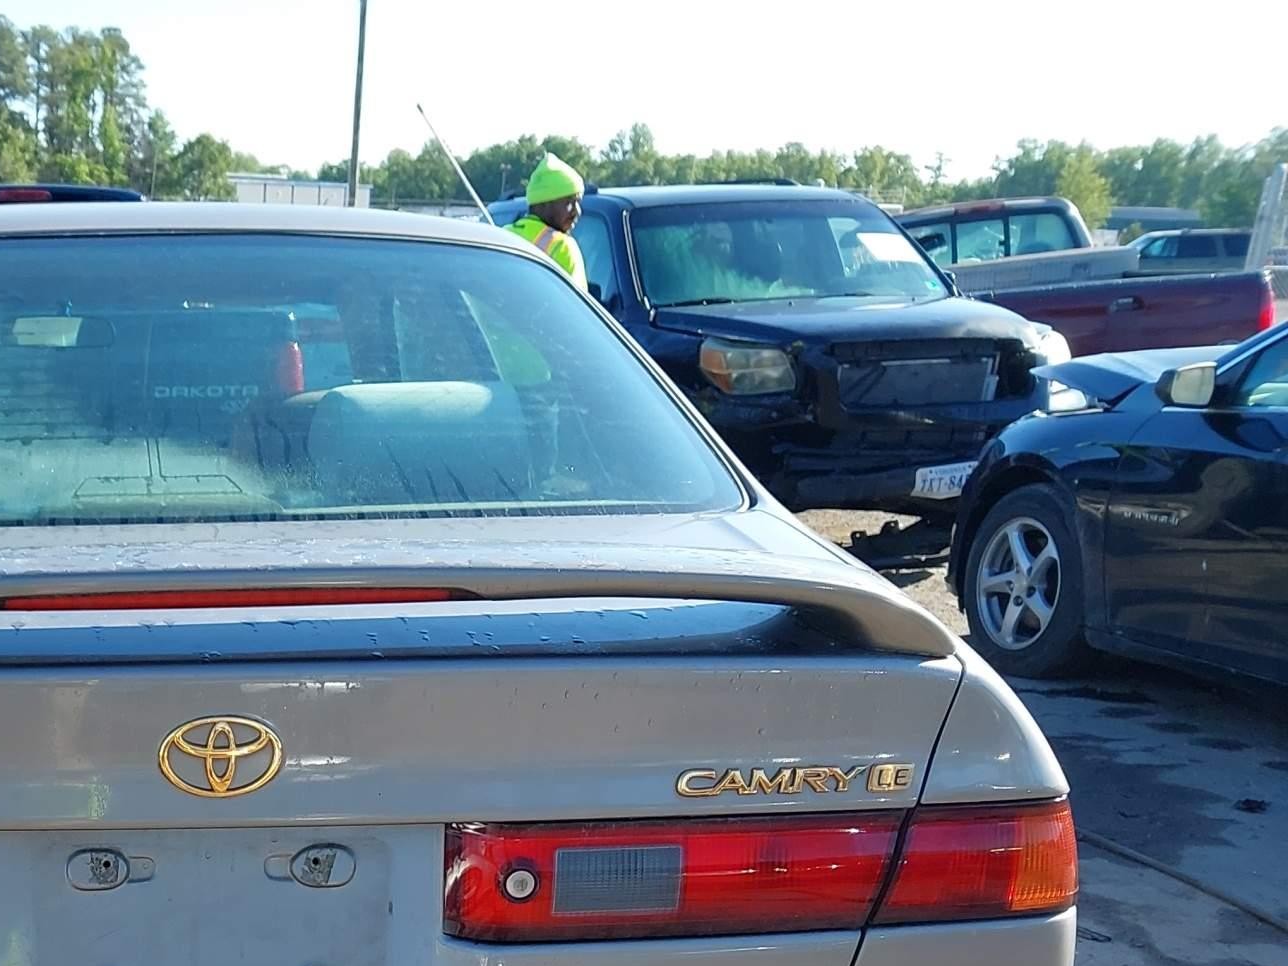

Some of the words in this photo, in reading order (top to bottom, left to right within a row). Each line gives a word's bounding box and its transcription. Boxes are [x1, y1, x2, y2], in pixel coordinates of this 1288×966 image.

[154, 384, 259, 398] DAKOTA
[676, 765, 869, 797] CAMRY
[873, 766, 912, 789] LE
